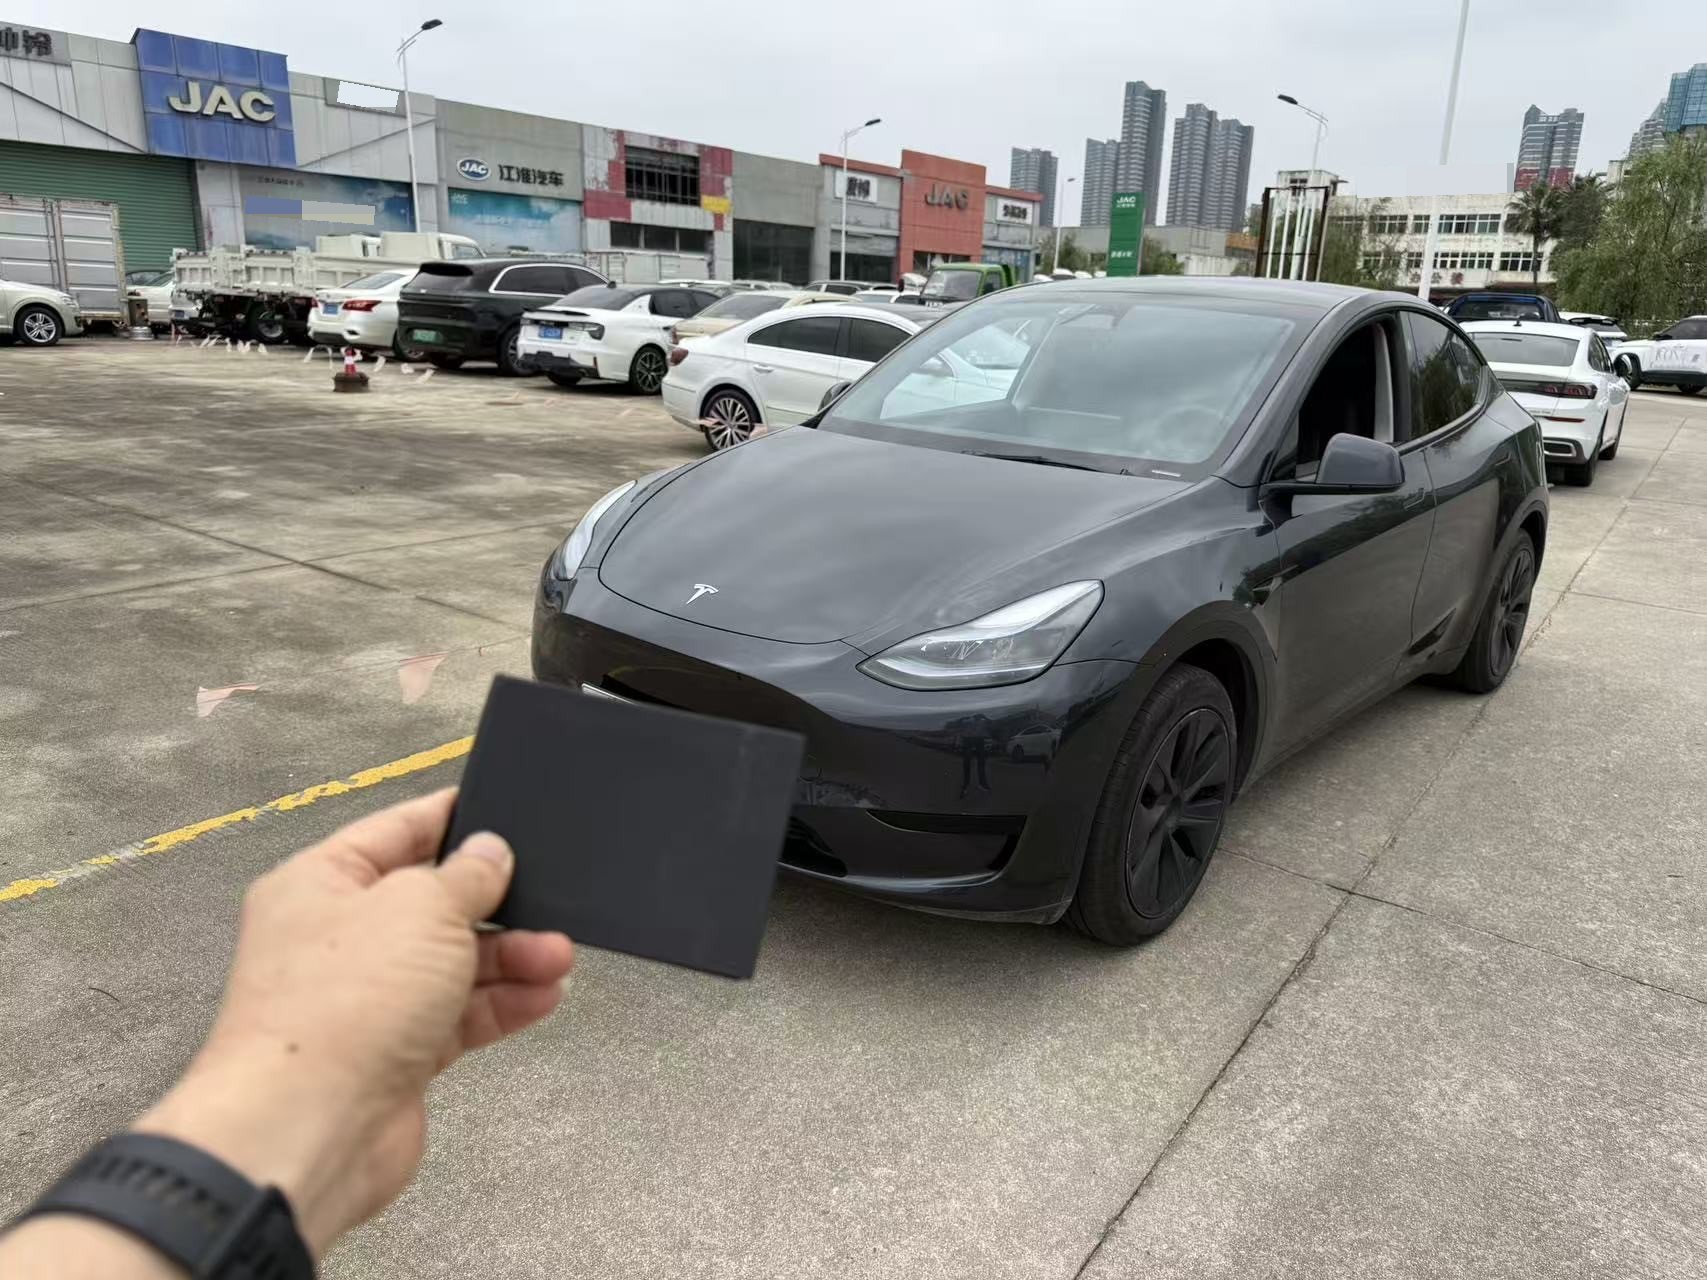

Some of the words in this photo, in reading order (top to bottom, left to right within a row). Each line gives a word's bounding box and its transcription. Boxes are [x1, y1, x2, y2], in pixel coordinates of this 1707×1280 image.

[167, 80, 276, 122] JAC
[461, 162, 488, 175] JAC
[498, 164, 565, 187] 江淮汽车
[924, 183, 969, 210] JAC
[1116, 195, 1137, 204] JAC
